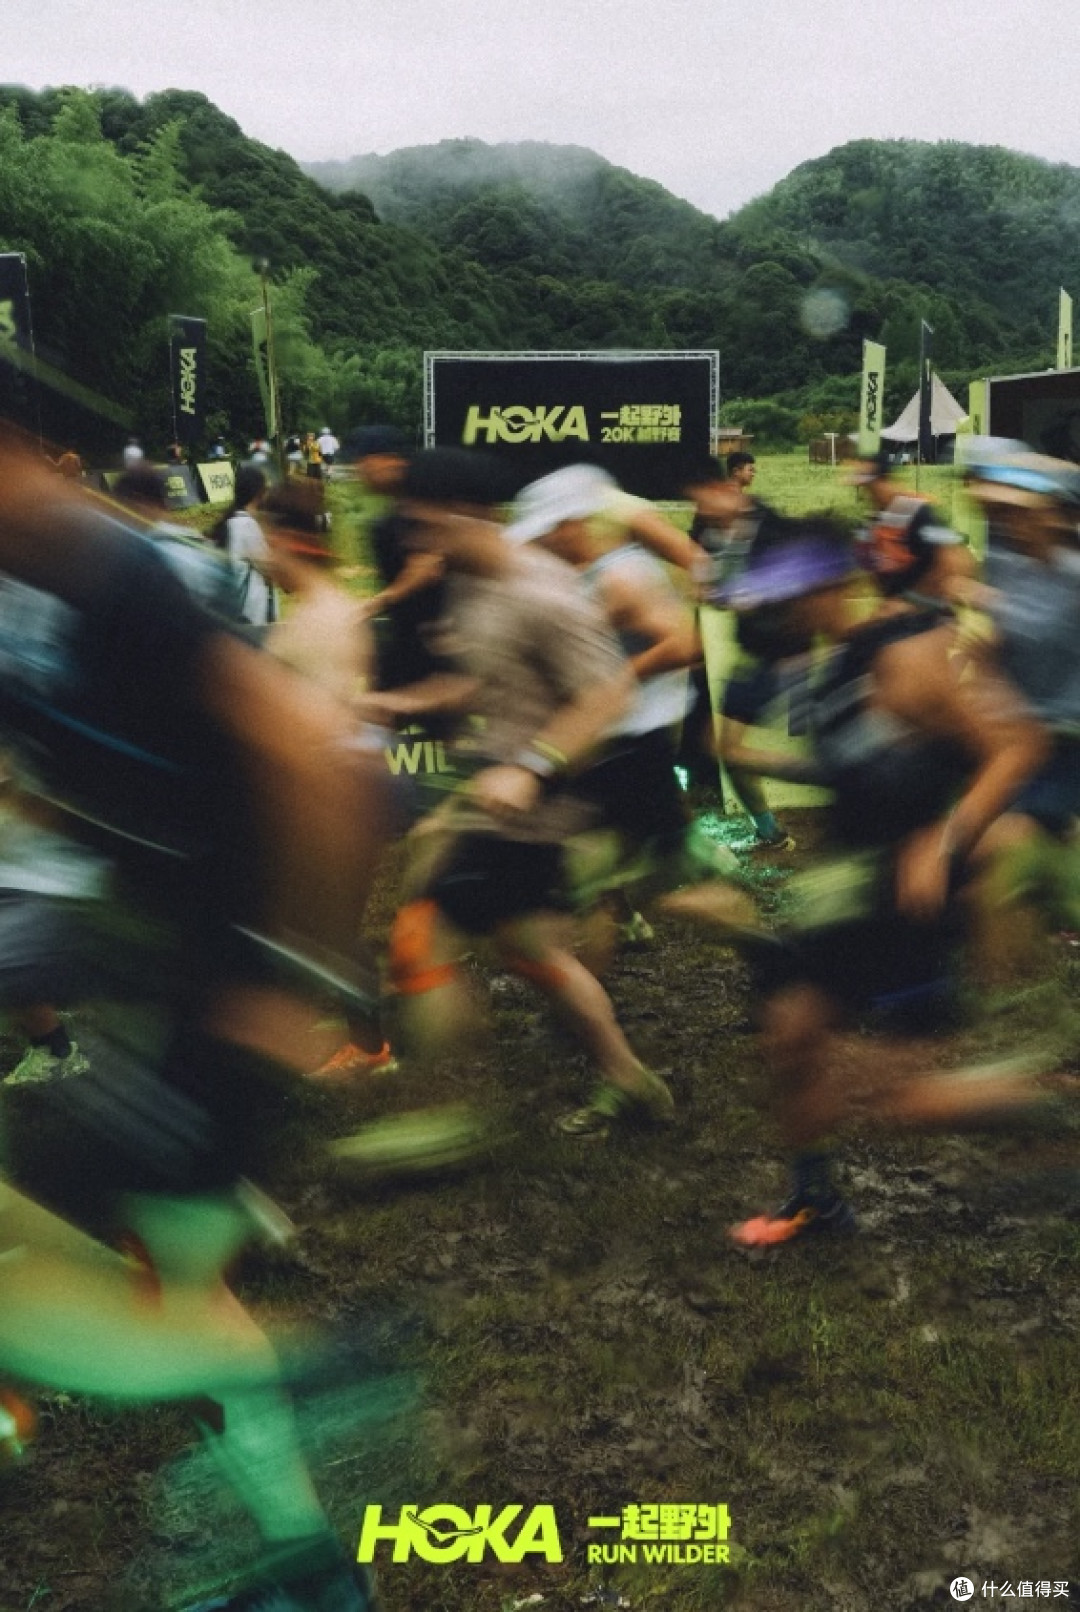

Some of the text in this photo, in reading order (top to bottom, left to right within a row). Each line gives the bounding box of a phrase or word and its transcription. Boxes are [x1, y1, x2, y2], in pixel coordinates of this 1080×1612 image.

[180, 348, 197, 415] HOKA
[463, 405, 590, 445] HOKA
[385, 741, 457, 775] WIL
